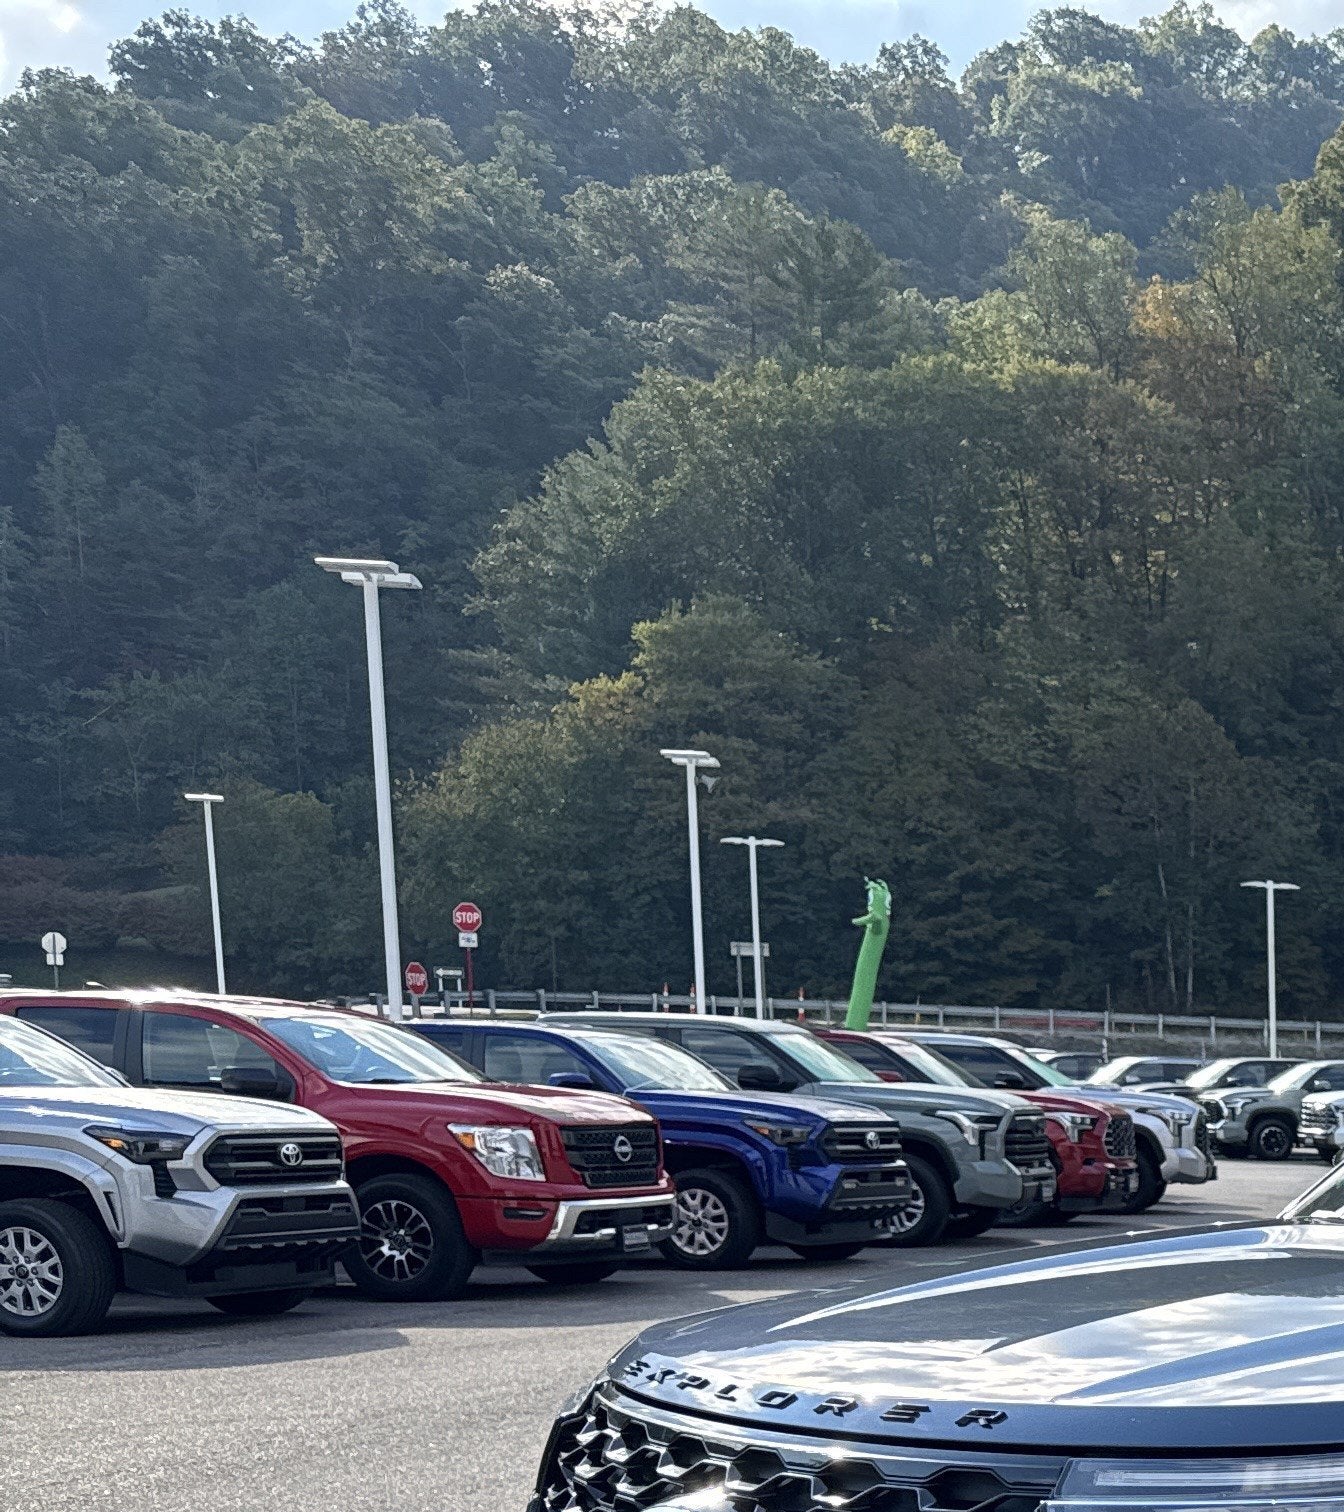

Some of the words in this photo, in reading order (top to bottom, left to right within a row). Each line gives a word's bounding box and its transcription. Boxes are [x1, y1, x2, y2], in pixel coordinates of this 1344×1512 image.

[455, 911, 480, 923] STOP
[406, 973, 425, 986] STOP
[624, 1359, 1009, 1430] EXPLORER
